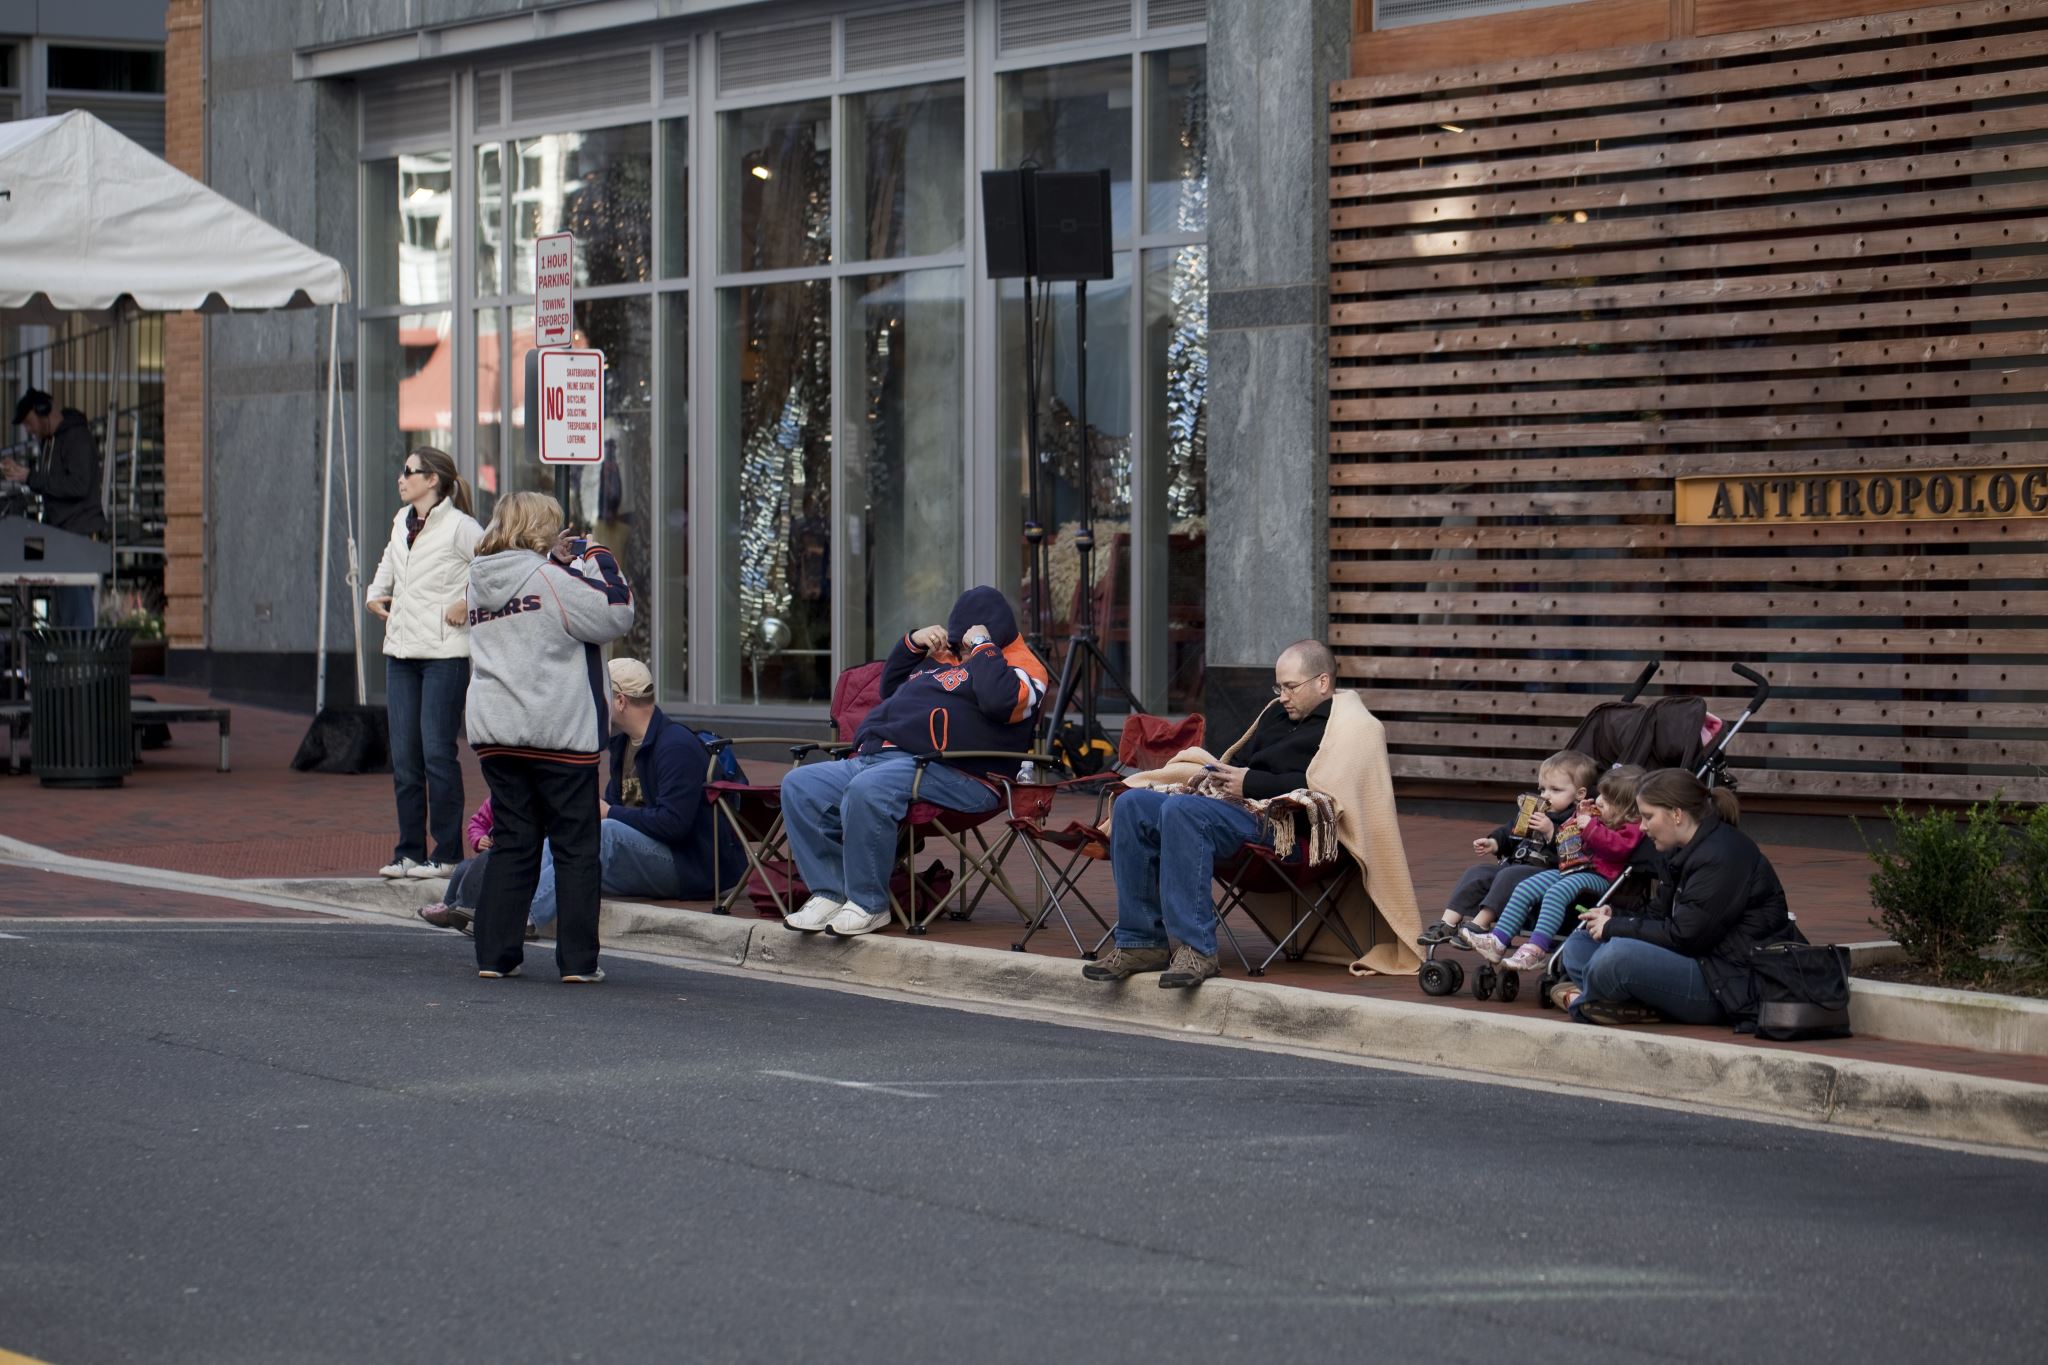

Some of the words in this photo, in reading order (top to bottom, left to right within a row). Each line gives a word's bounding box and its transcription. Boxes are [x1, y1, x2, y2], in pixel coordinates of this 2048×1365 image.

[541, 256, 546, 270] 1
[548, 253, 568, 269] HOUR
[539, 273, 570, 289] PARKING
[542, 298, 565, 311] TOWING
[539, 314, 569, 328] ENFORCED
[567, 368, 597, 378] SKATEBOARDING
[579, 382, 595, 391] SKATING
[547, 387, 564, 421] NO
[567, 395, 586, 404] BICYCLING
[567, 408, 587, 417] SOLICITING
[567, 422, 591, 430] TRESPASSING
[592, 422, 597, 430] OR
[567, 435, 586, 444] LOITERING
[1708, 472, 2048, 519] ANTHROPOLOG
